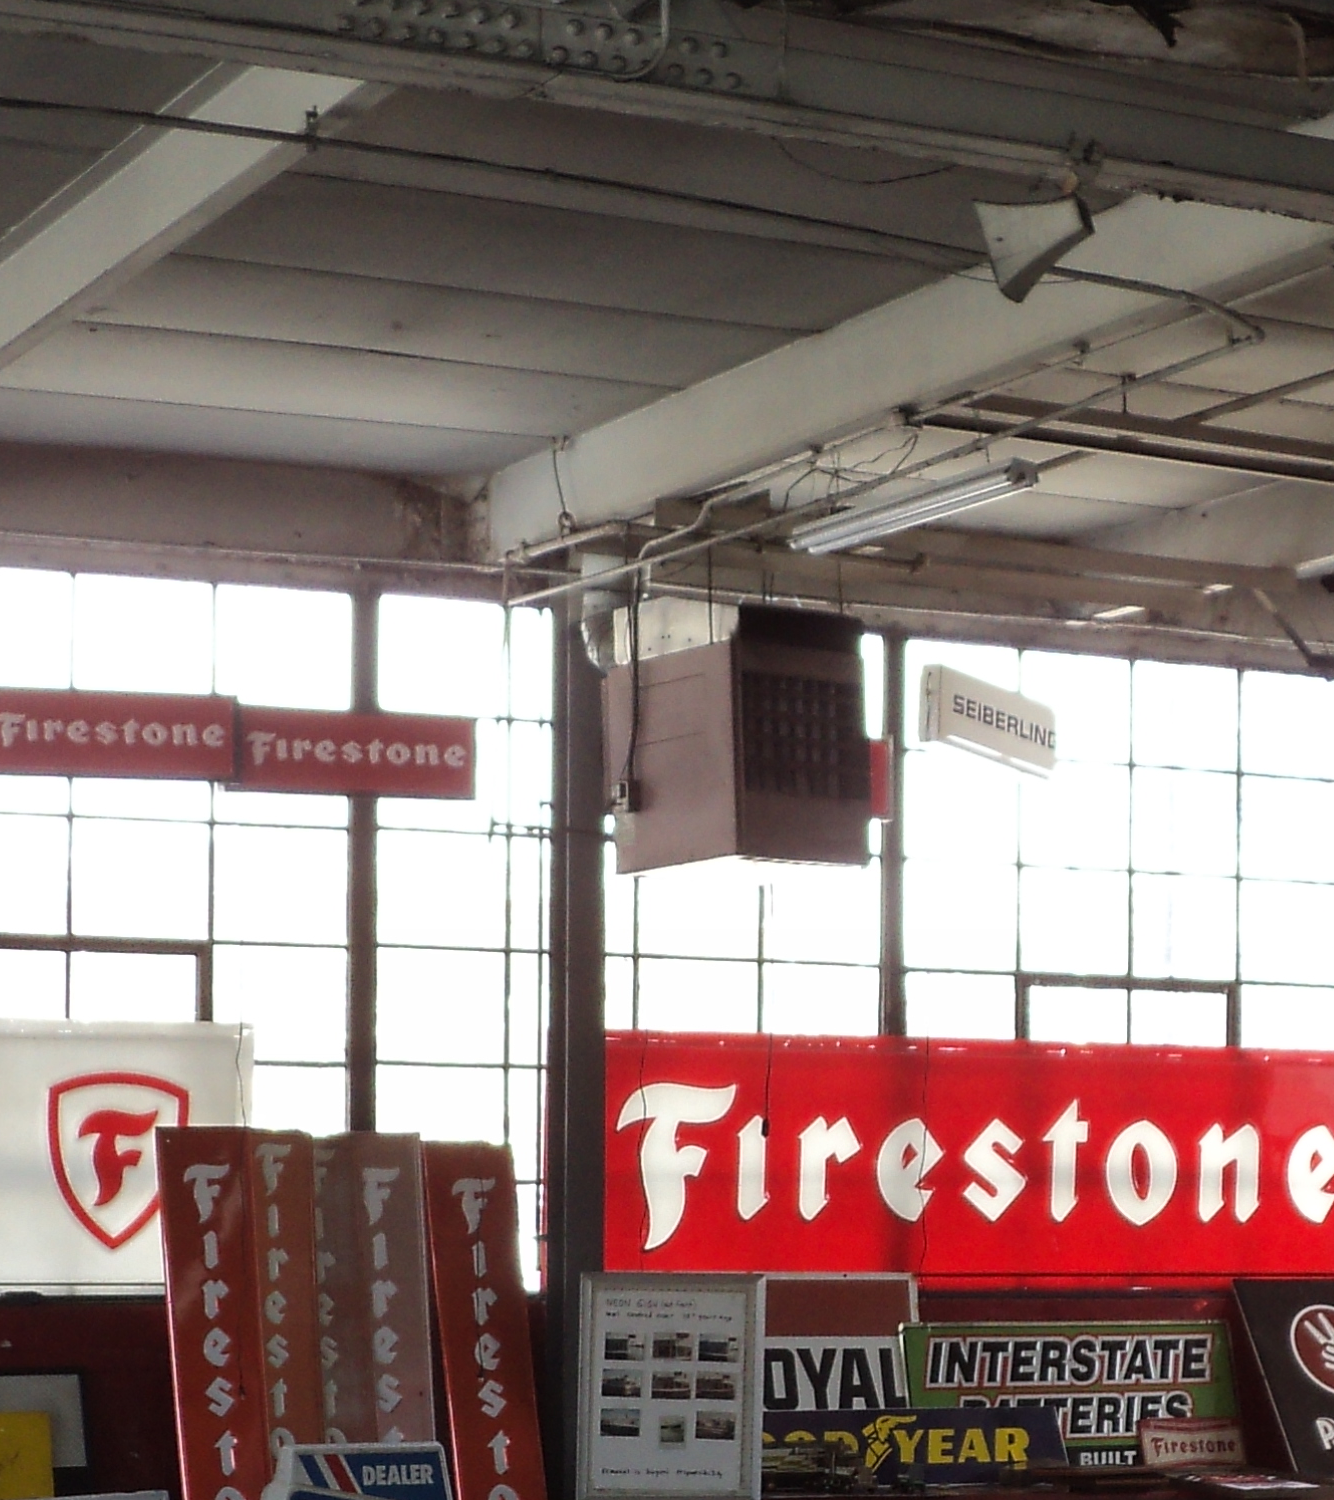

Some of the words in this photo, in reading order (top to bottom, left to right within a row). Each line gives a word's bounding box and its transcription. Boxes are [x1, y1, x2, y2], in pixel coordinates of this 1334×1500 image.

[952, 694, 1056, 749] SEIBERLING
[246, 730, 467, 768] Firestone
[254, 1143, 296, 1459] Firesto
[765, 1346, 910, 1410] OYAL
[926, 1333, 1213, 1390] INTERSTATE
[960, 1391, 1194, 1440] TERIES
[1080, 1450, 1137, 1466] BUILT
[1151, 1435, 1236, 1457] Firestone
[362, 1463, 434, 1486] DEALER
